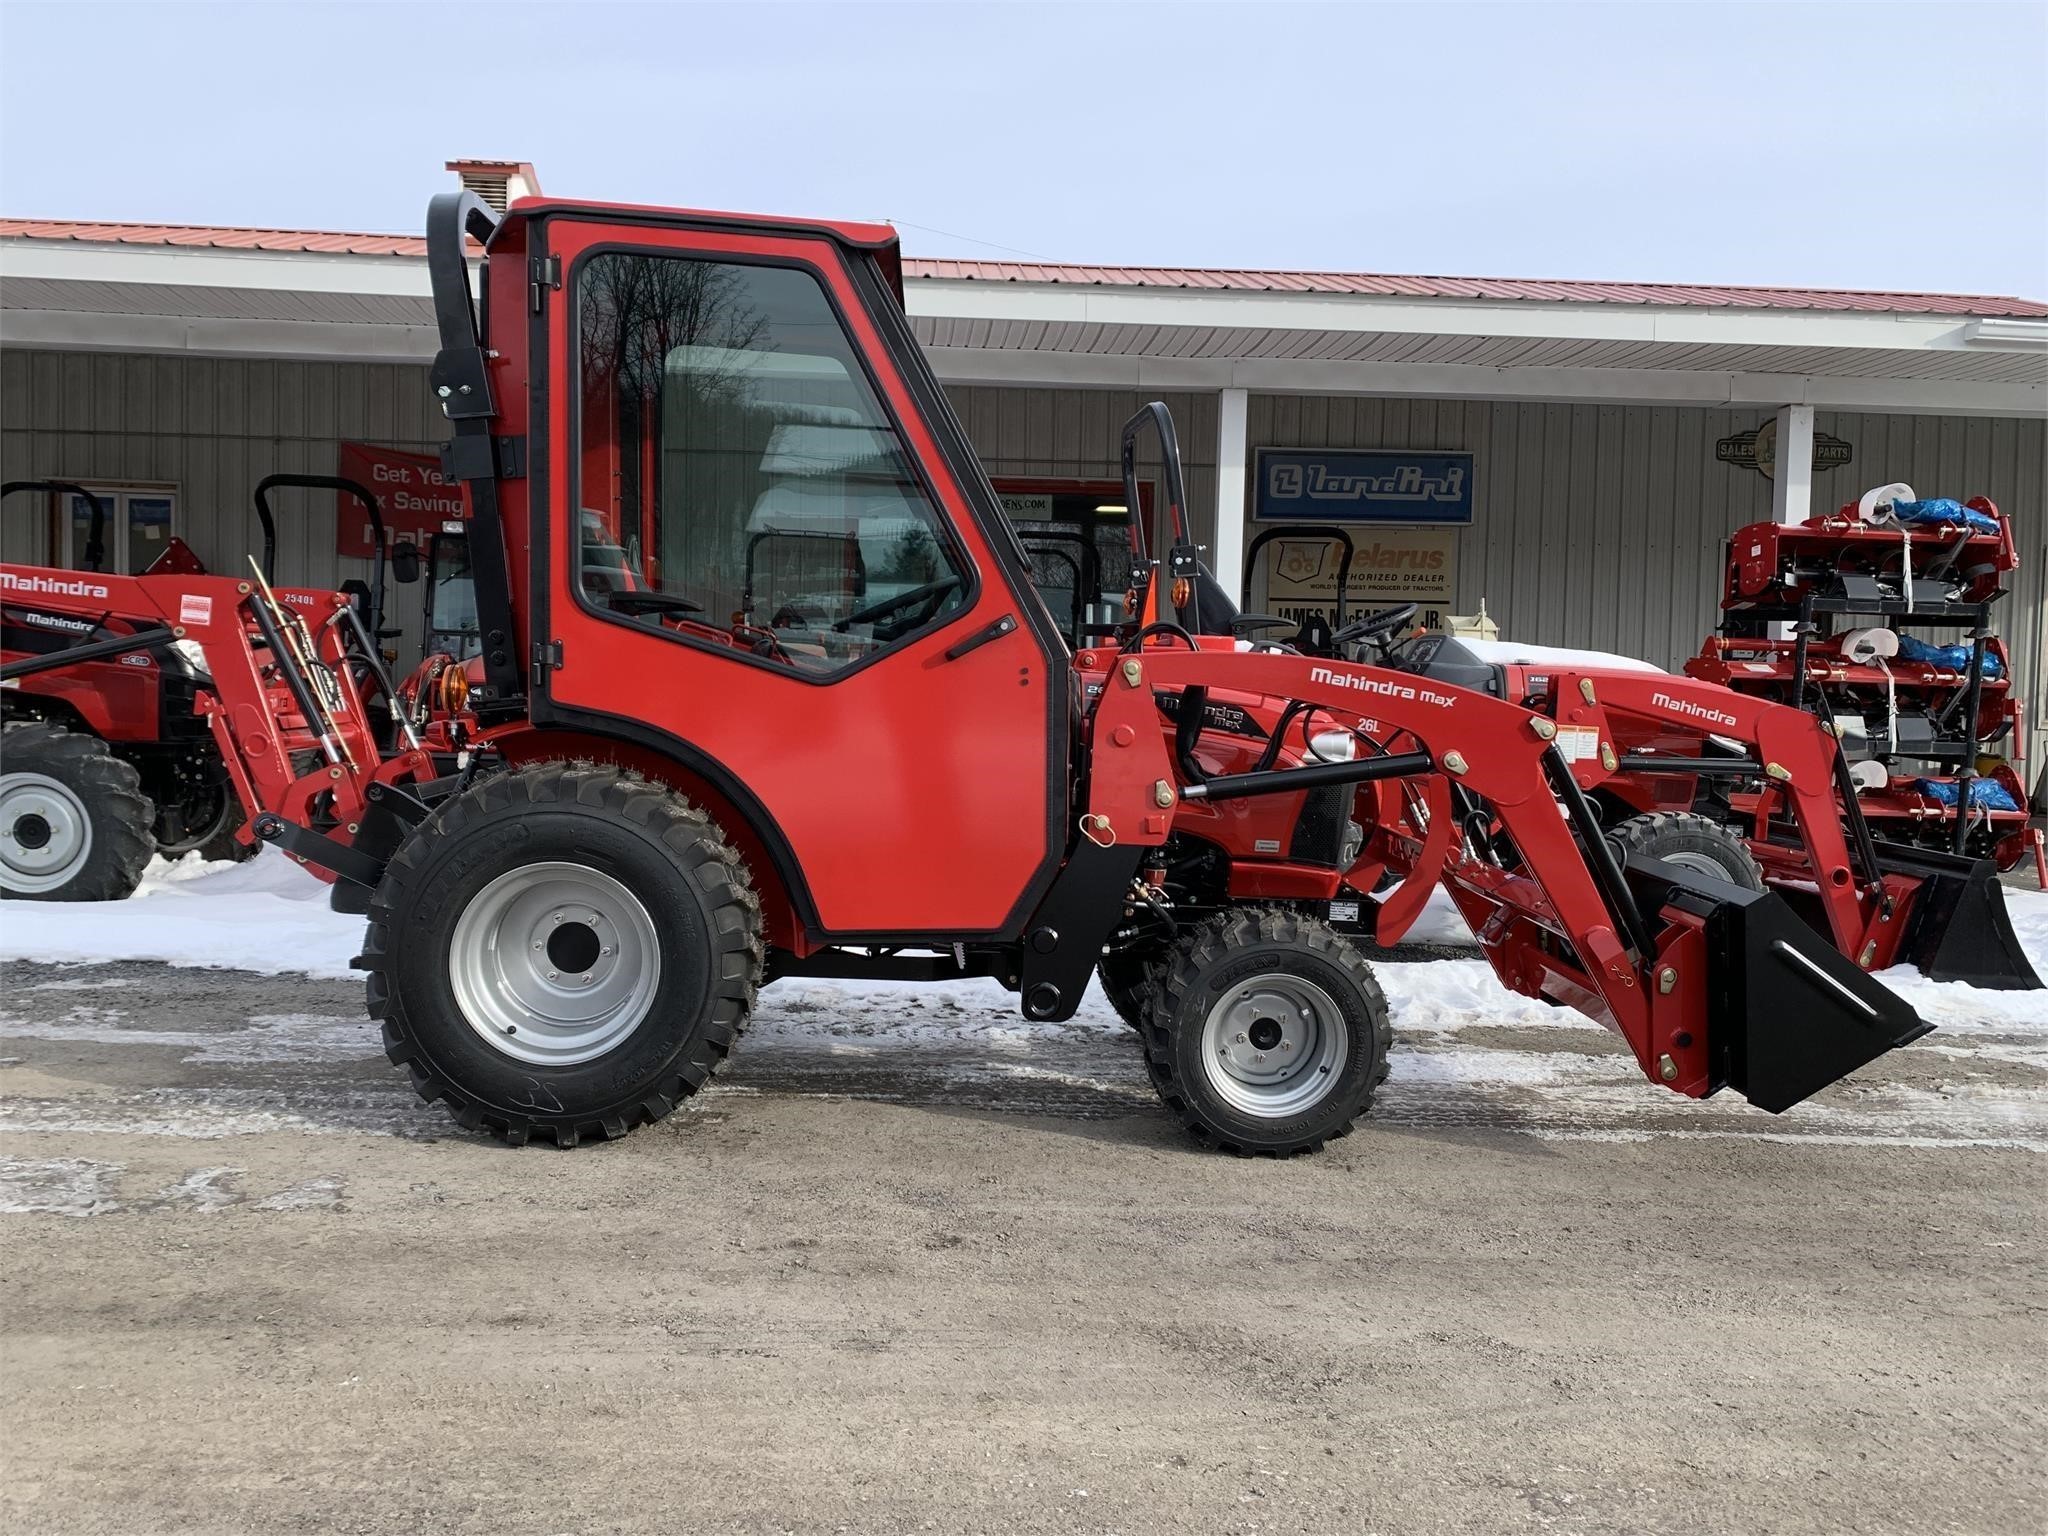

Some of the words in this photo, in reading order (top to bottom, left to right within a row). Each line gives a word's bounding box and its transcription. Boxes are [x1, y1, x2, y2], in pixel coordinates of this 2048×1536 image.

[1720, 444, 1755, 456] SALES
[1818, 446, 1849, 458] PARTS
[373, 463, 411, 483] Get
[1403, 573, 1445, 582] DEALER
[1420, 610, 1443, 629] JR.
[1310, 667, 1415, 699] Mahindra
[1652, 692, 1738, 727] Mahindra
[1357, 718, 1381, 733] 26L
